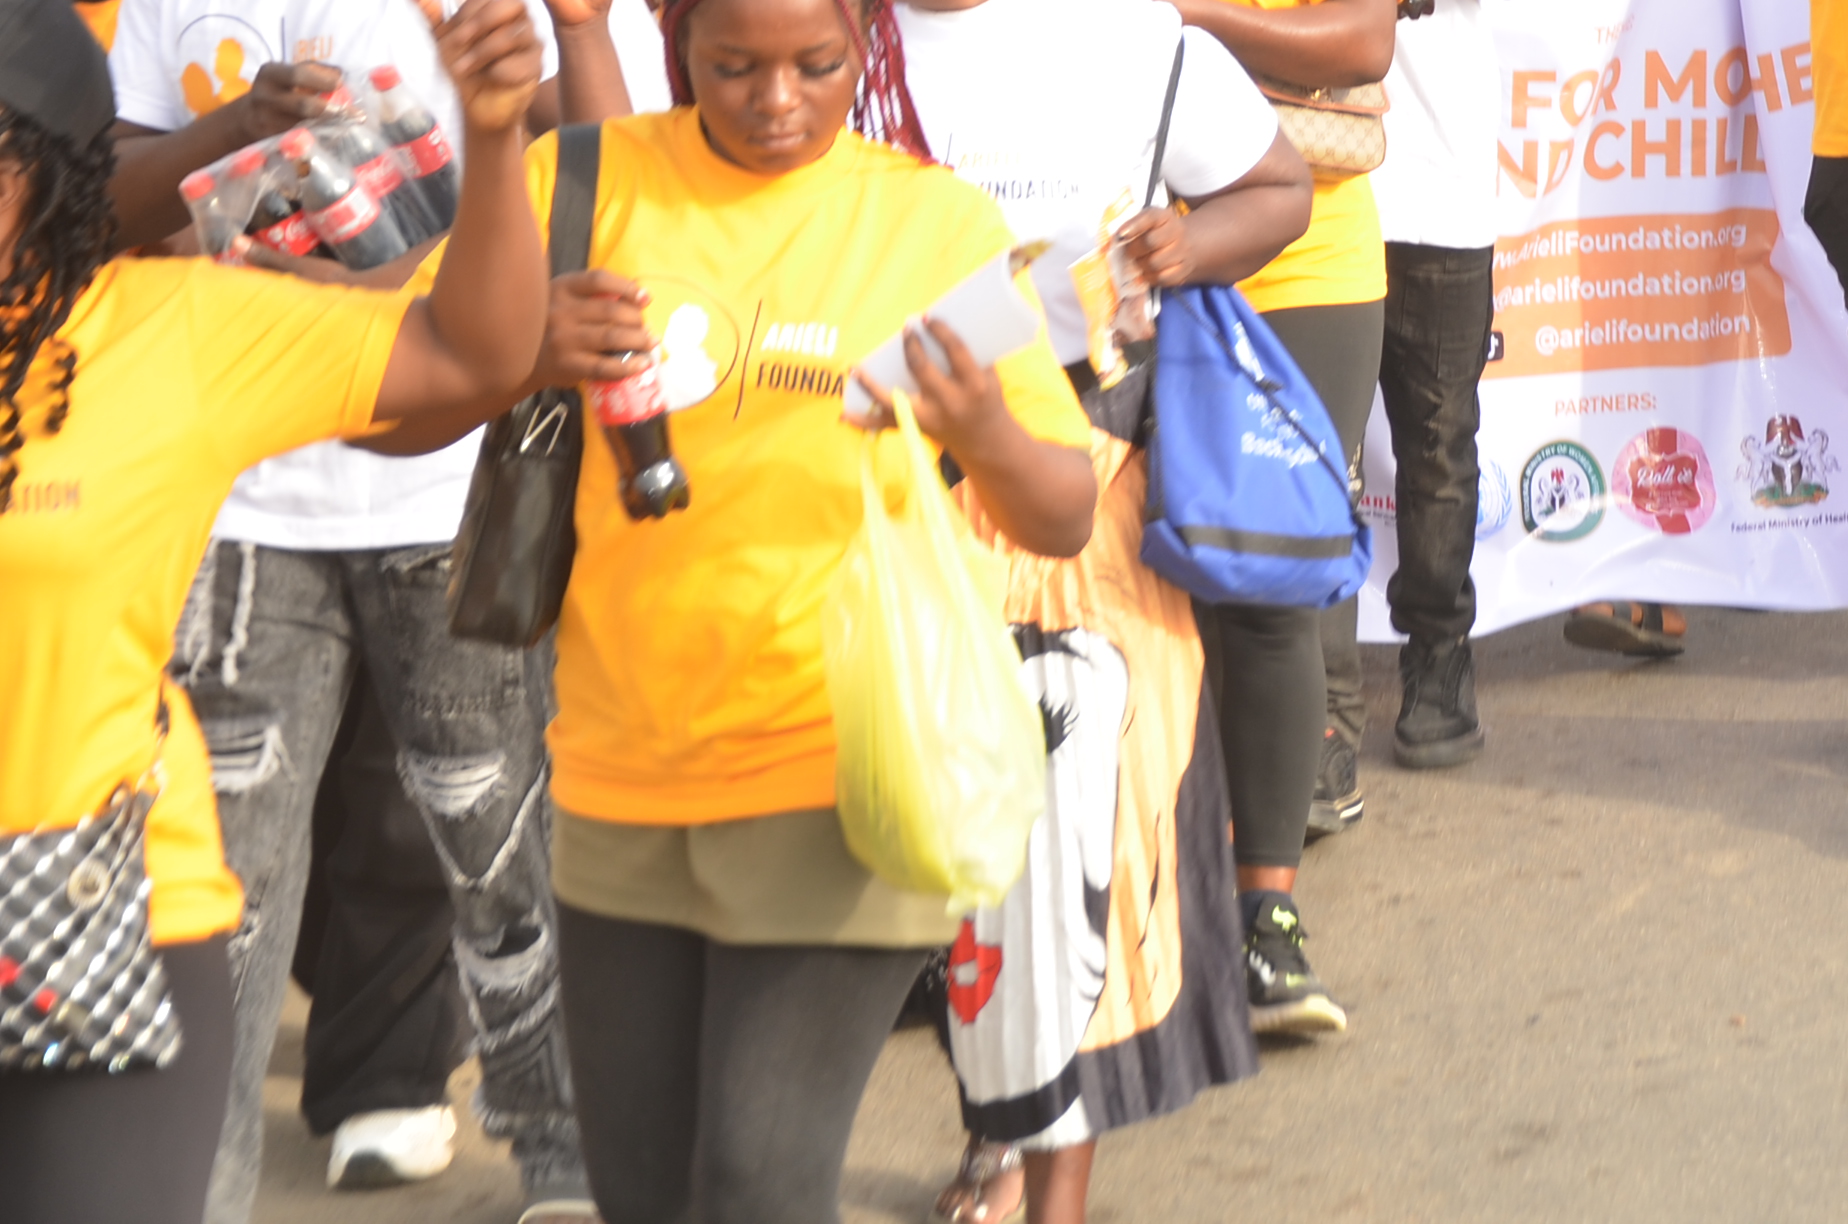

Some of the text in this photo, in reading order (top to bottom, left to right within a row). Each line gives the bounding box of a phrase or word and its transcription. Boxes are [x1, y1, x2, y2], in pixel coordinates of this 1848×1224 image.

[1511, 55, 1622, 129] FOR
[1493, 267, 1747, 313] @arielifoundation.org
[760, 321, 838, 358] ARIELI
[1534, 312, 1751, 356] @arielifoundation
[756, 362, 844, 400] FOUNDA
[1554, 392, 1658, 417] PARTNERS:
[1730, 519, 1766, 533] Federal
[1768, 515, 1810, 530] Ministry
[1812, 514, 1823, 526] of
